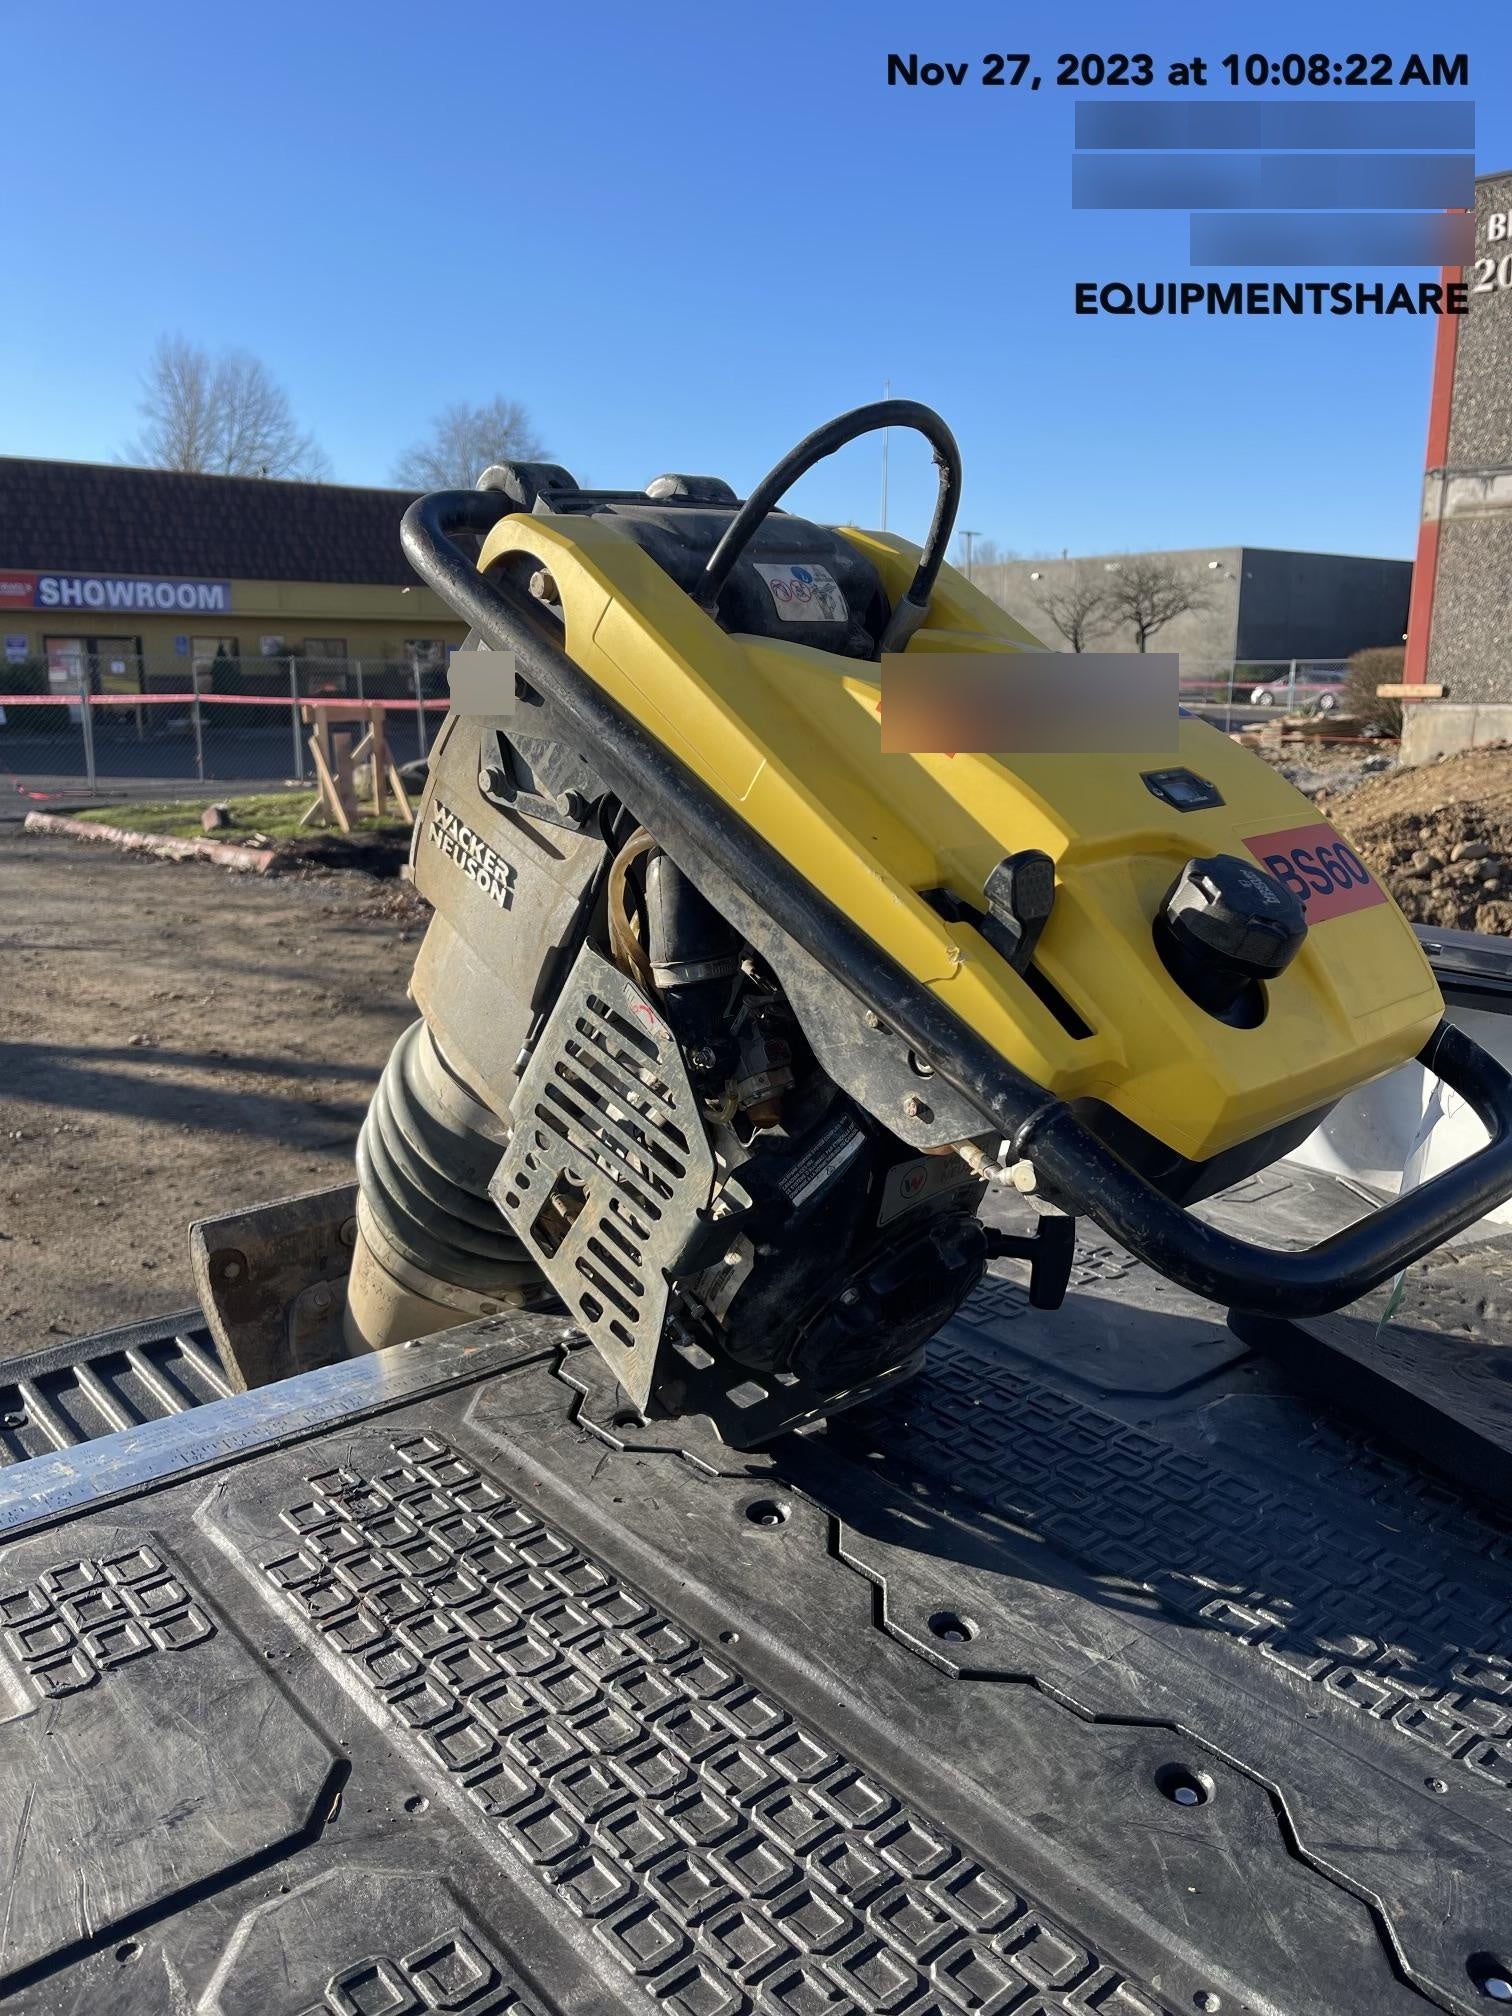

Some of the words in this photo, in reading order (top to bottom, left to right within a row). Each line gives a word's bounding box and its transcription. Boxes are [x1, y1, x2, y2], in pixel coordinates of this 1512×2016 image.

[39, 577, 225, 609] SHOWROOM
[429, 821, 507, 908] NEUSON
[433, 799, 509, 888] WACKER
[1262, 842, 1370, 901] BS60
